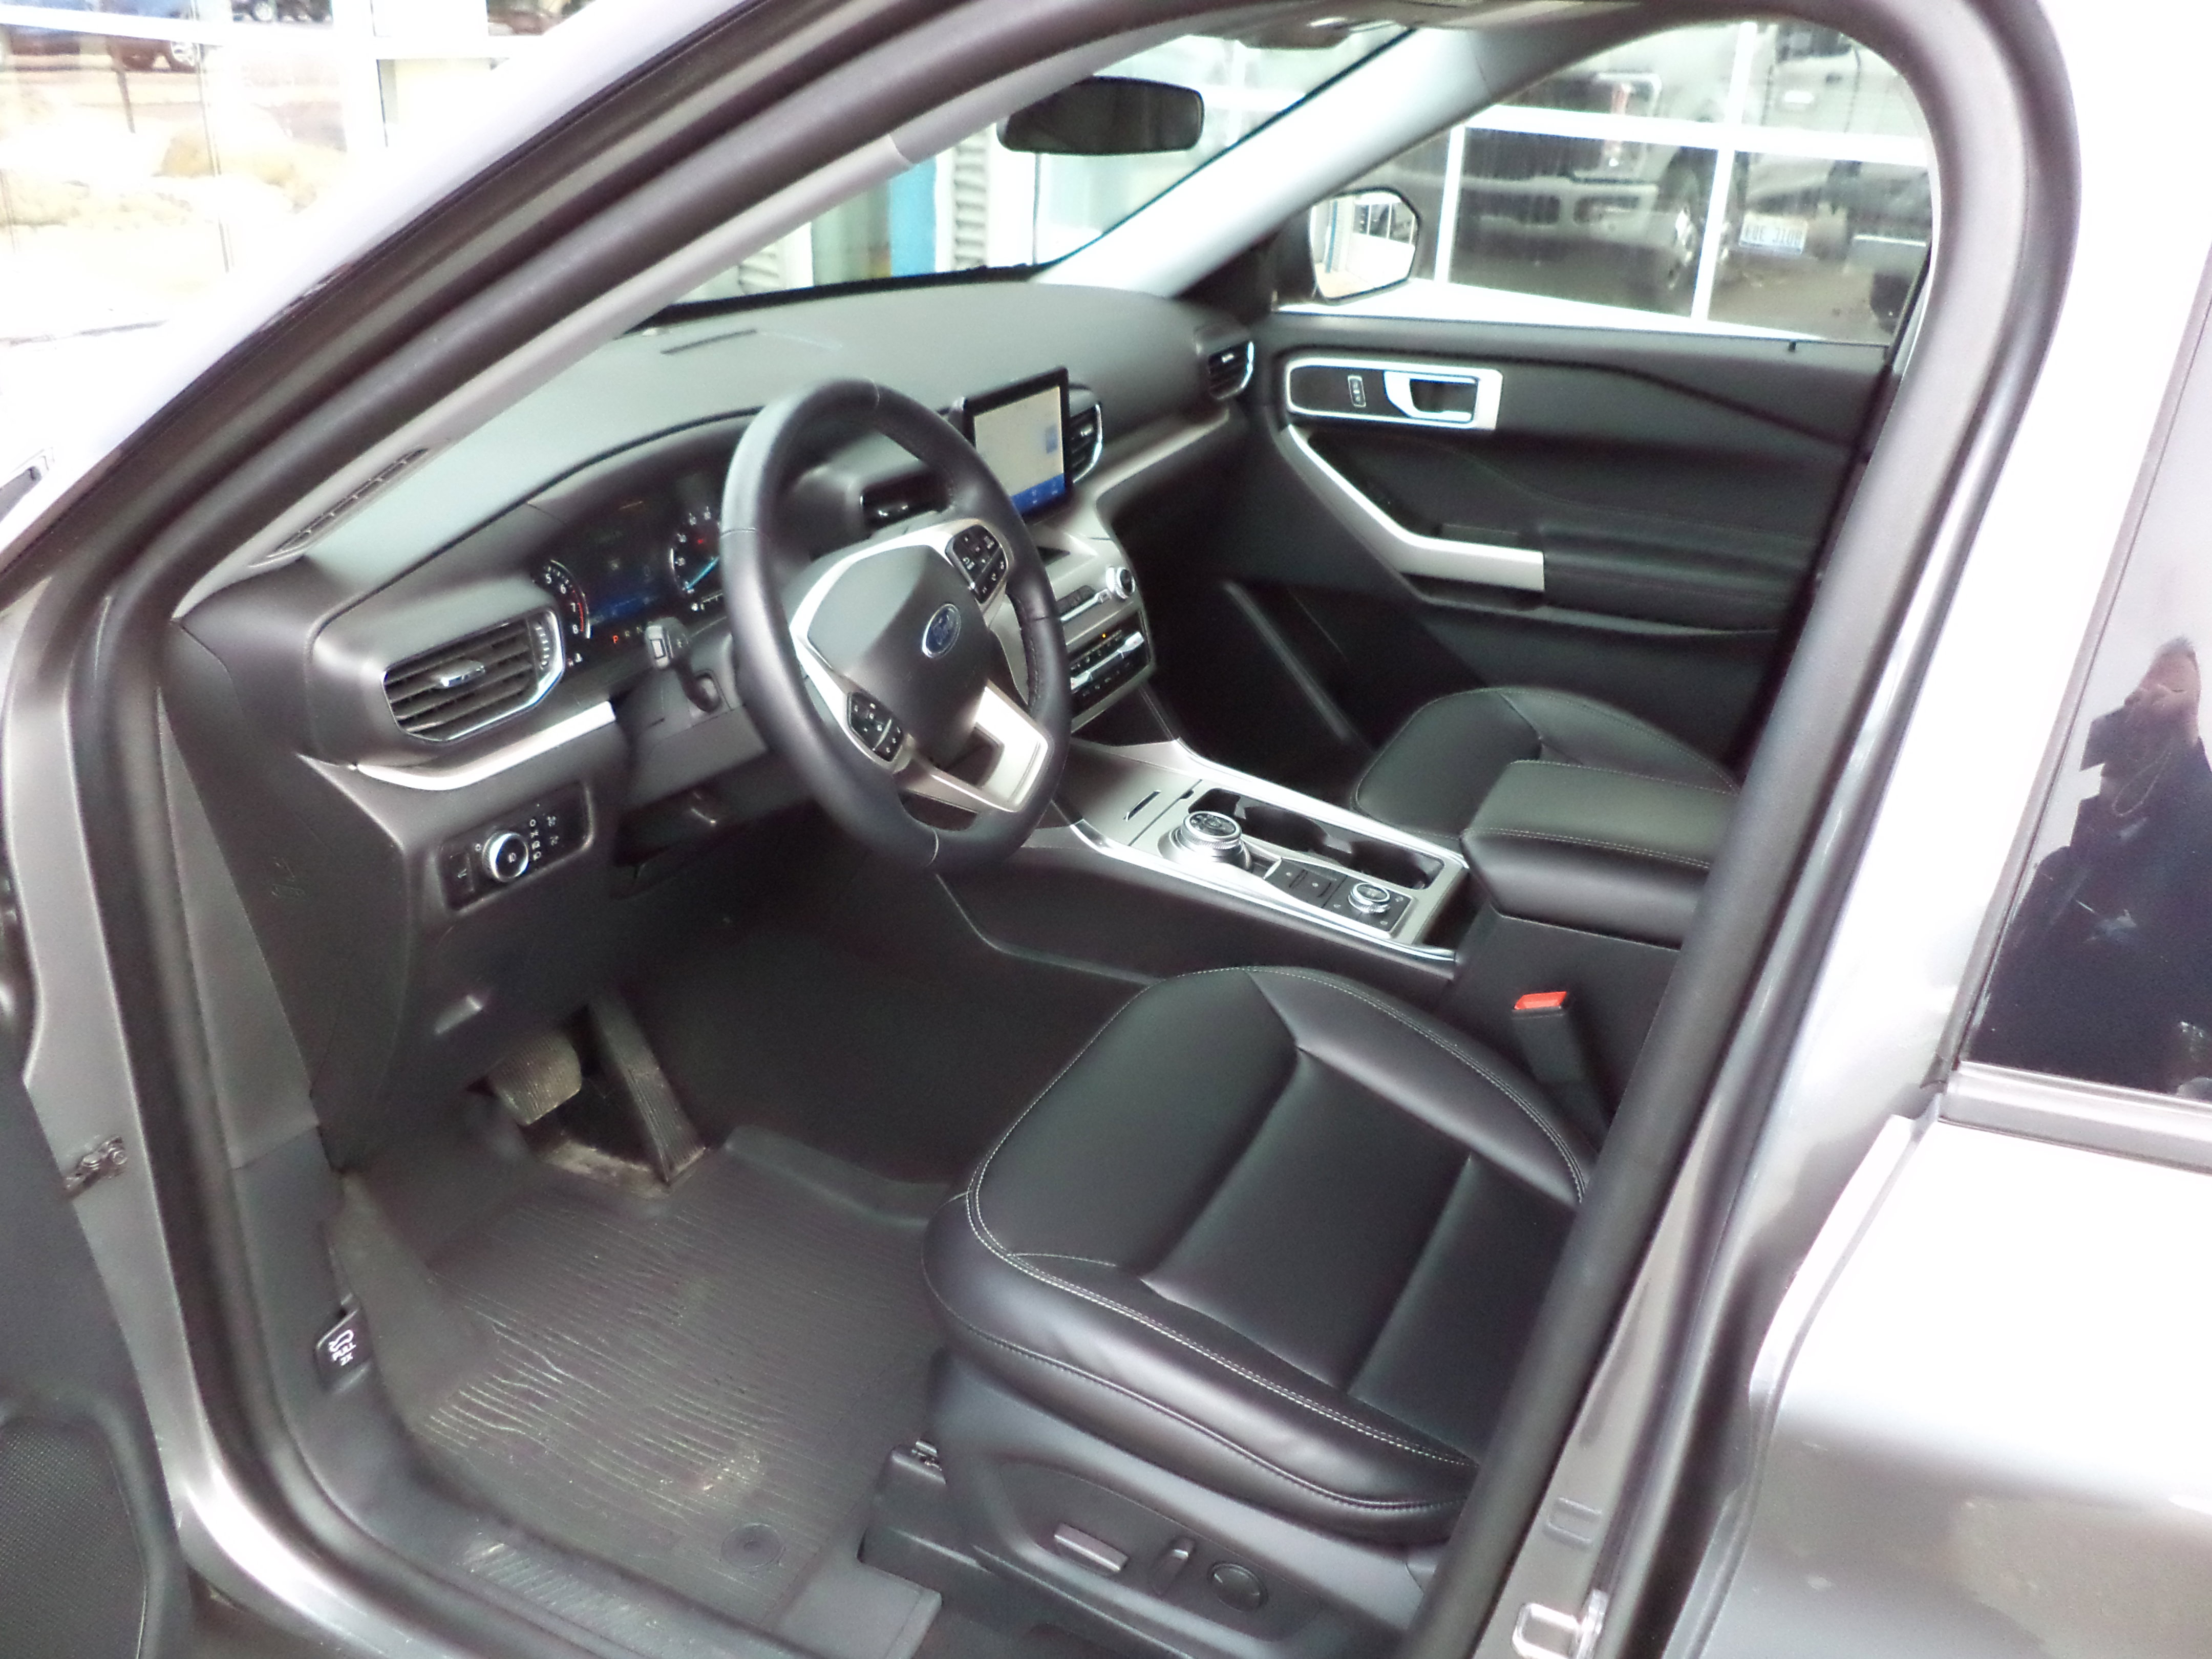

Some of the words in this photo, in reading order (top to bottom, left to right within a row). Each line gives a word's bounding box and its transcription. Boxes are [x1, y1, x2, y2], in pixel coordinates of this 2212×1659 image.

[545, 572, 552, 584] 5
[560, 584, 566, 594] 6
[572, 624, 579, 634] 8
[612, 635, 619, 644] P
[331, 1342, 357, 1362] PULL
